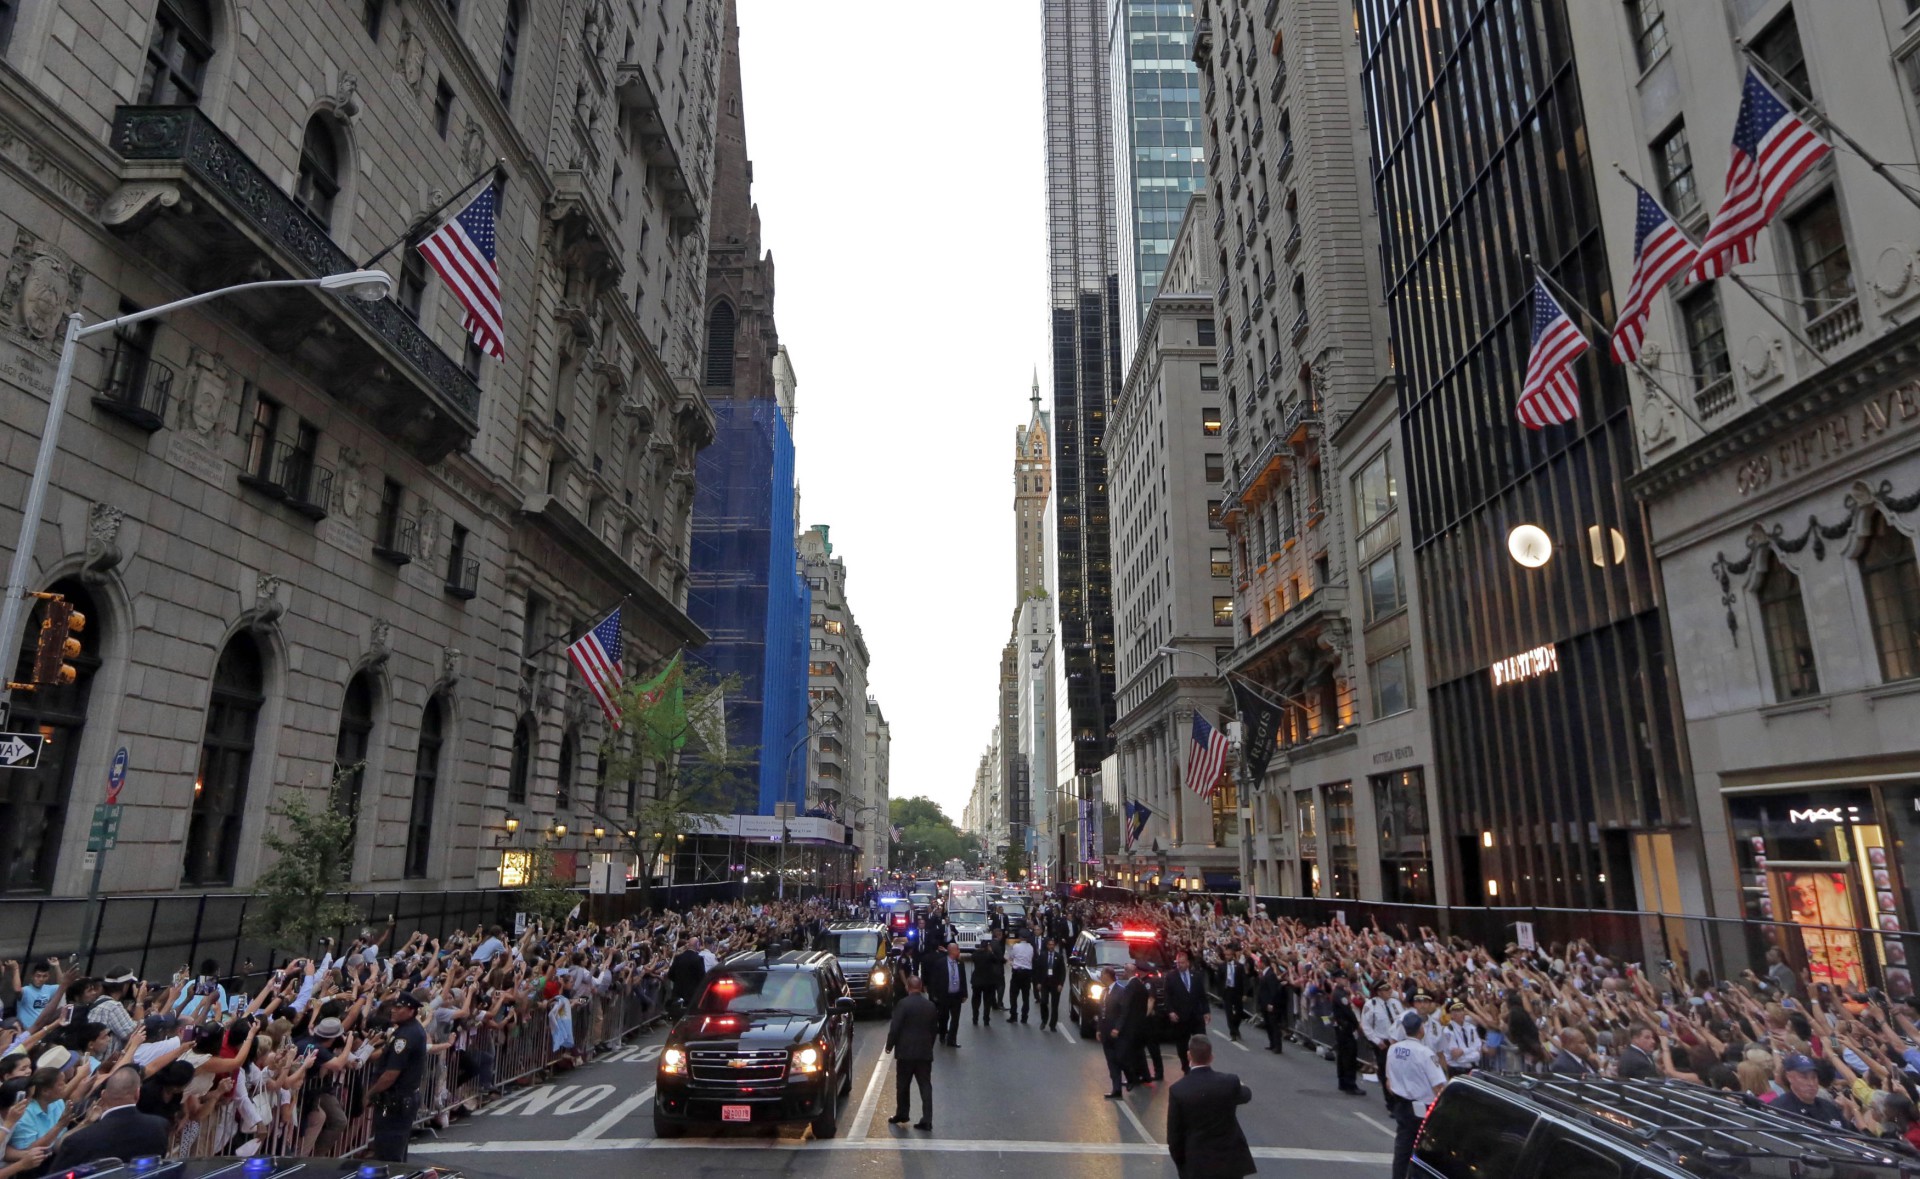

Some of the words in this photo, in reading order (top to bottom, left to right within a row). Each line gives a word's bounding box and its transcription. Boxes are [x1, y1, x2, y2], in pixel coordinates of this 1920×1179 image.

[1736, 455, 1772, 496] 689
[1777, 415, 1854, 477] FIFTH
[1860, 379, 1920, 439] AVE
[1250, 710, 1271, 759] REGIS
[1394, 1046, 1411, 1057] NYPD
